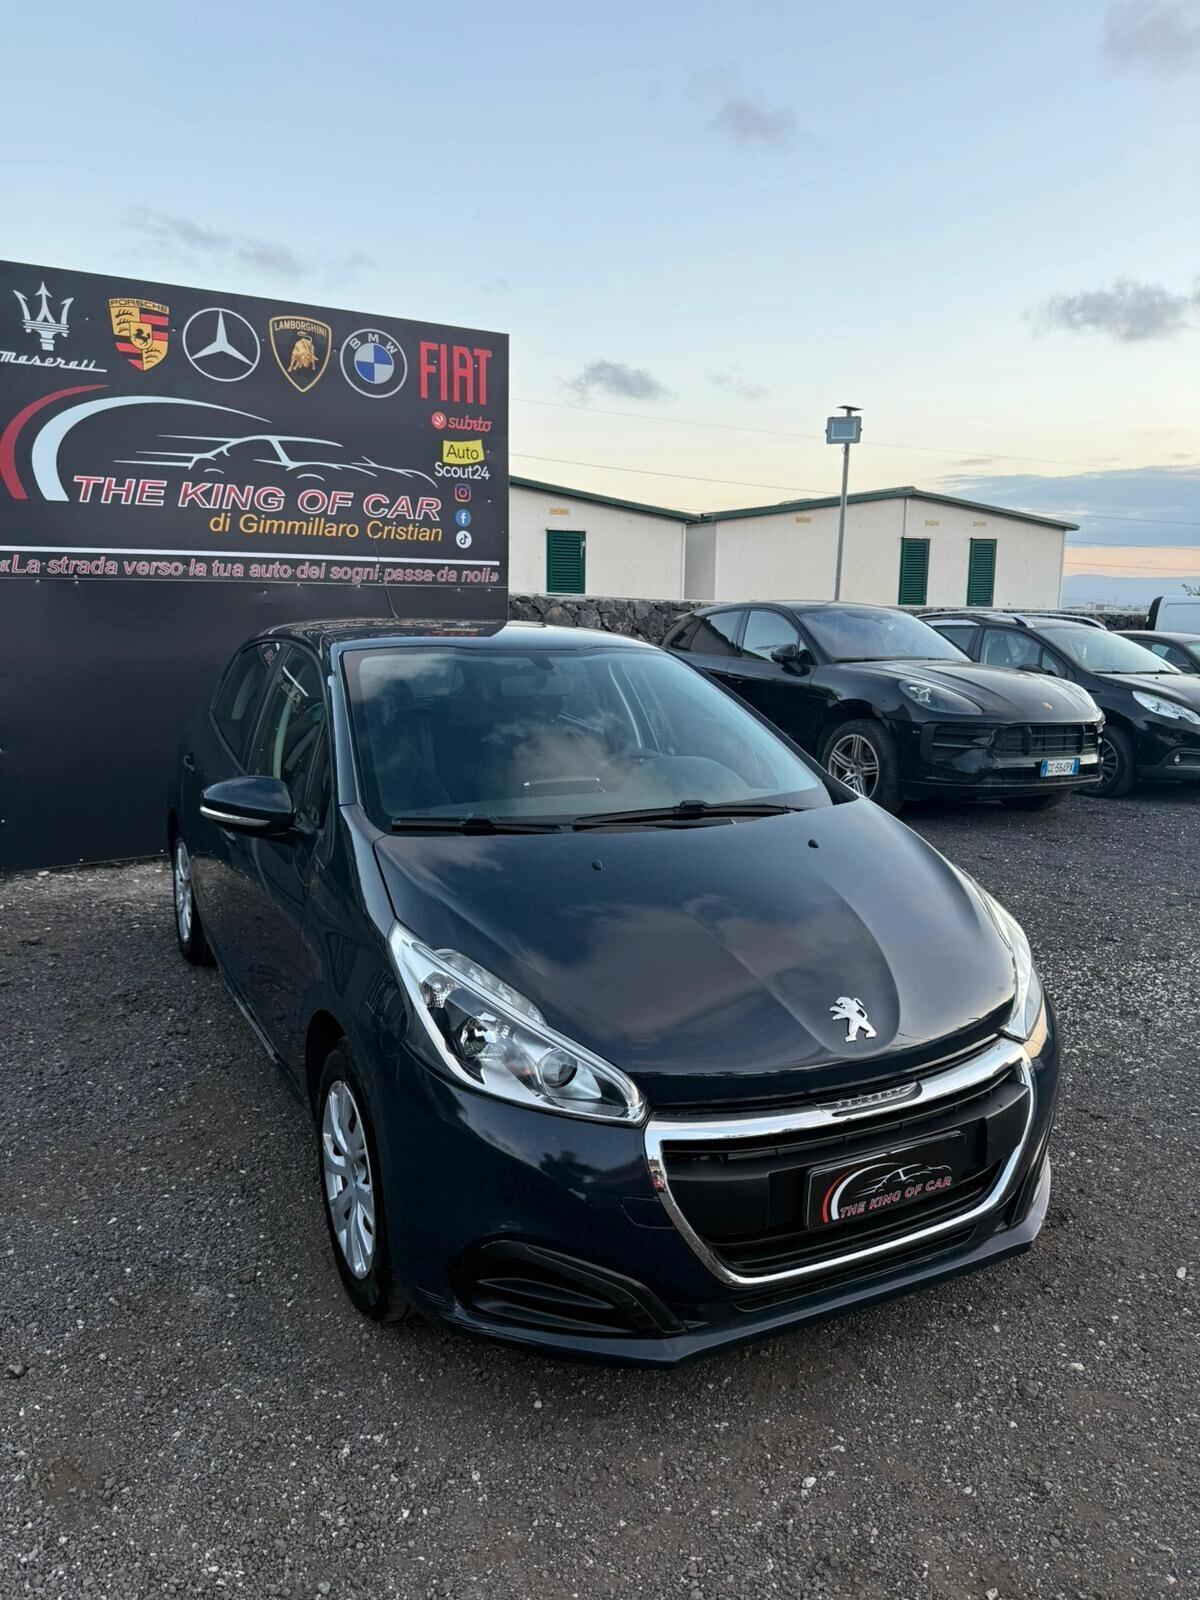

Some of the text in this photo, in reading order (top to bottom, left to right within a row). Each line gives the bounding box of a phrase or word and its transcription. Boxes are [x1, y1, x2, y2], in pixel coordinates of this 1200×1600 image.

[110, 298, 168, 313] PORSCHE
[274, 320, 327, 338] LAMBORGHINI
[349, 332, 398, 355] BMW
[419, 340, 492, 406] FIAT
[446, 444, 479, 460] Auto
[434, 461, 491, 480] Scout24
[73, 475, 442, 521] THE KING OF CAR
[209, 512, 443, 542] di Gimmillaro Cristian
[47, 555, 118, 575] strada
[123, 559, 184, 576] verso
[188, 558, 207, 577] la
[211, 559, 244, 577] tua
[249, 561, 292, 578] auto
[296, 561, 326, 579] dei
[329, 563, 380, 585] sogni
[383, 567, 434, 585] passa
[436, 566, 457, 582] da
[840, 1175, 953, 1219] THE KING OF CAR
